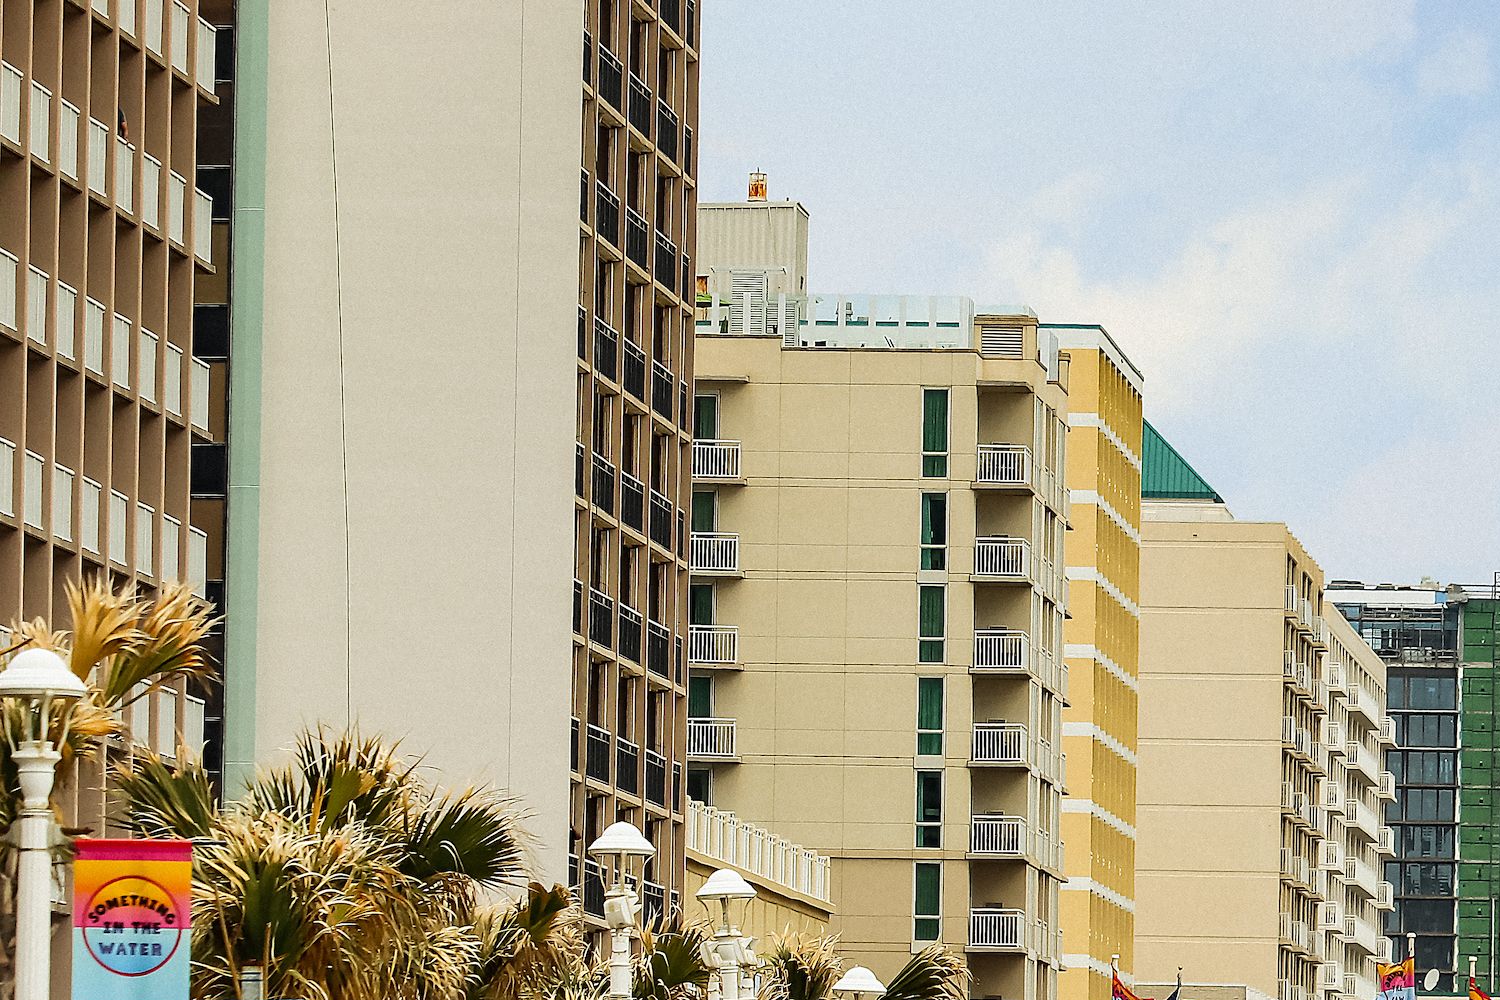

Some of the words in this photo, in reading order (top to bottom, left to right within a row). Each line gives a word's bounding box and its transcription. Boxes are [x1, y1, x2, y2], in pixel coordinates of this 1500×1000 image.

[88, 895, 175, 925] SOMETHING
[103, 922, 124, 934] IN
[131, 922, 161, 935] THE
[98, 942, 162, 956] WATER
